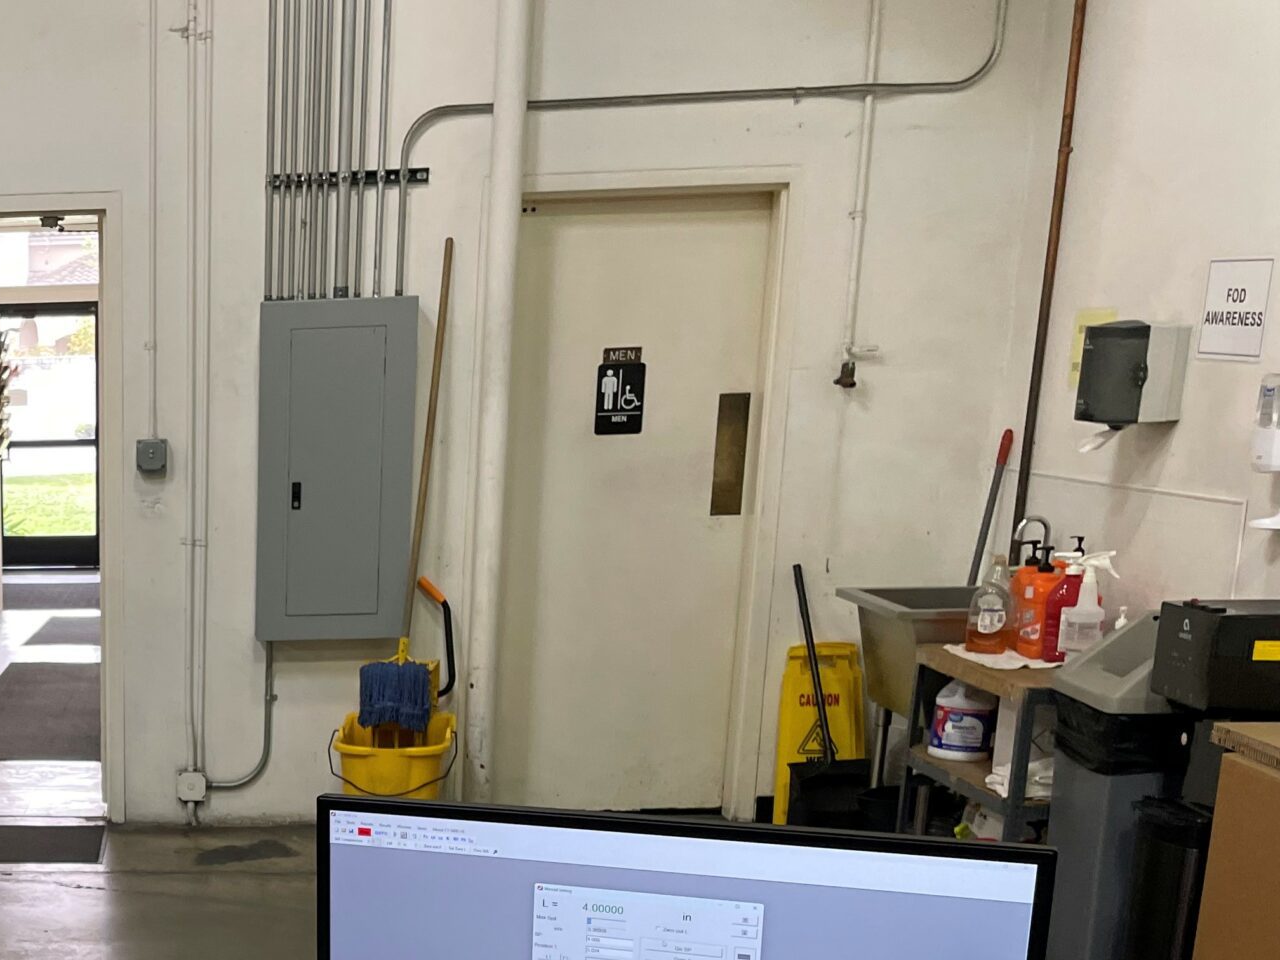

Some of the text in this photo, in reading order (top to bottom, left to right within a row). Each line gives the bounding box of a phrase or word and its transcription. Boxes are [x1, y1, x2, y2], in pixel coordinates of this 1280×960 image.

[1226, 288, 1247, 303] FOD
[1204, 311, 1264, 327] AWARENESS
[610, 350, 636, 361] MEN
[542, 899, 549, 908] L
[582, 903, 624, 915] 4.00000
[682, 912, 692, 921] in
